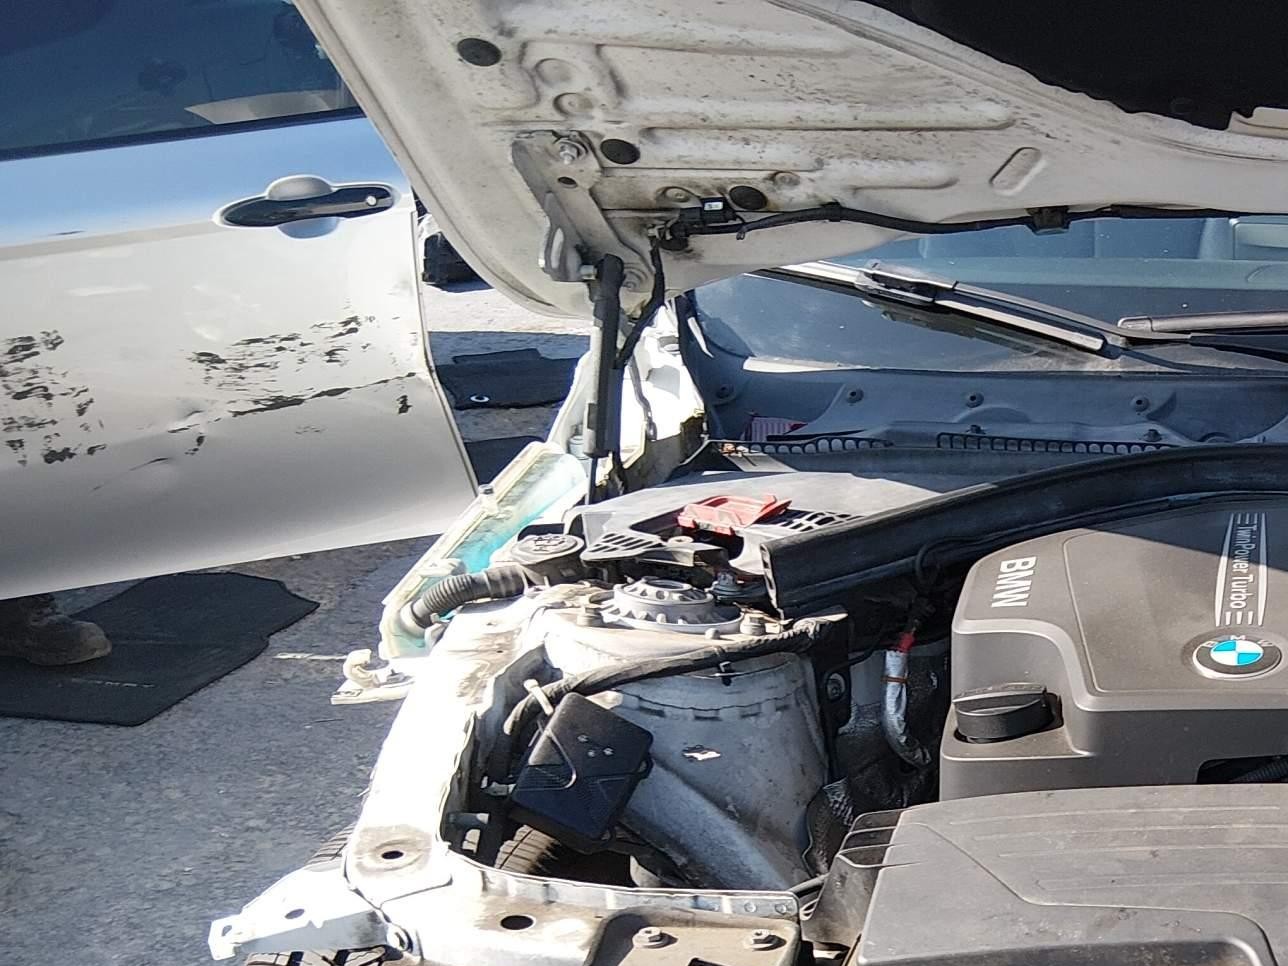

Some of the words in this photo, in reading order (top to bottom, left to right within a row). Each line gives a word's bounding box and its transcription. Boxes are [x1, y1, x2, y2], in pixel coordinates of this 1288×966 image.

[1232, 523, 1257, 573] TwinPower
[991, 556, 1037, 608] BMW
[1229, 573, 1254, 609] Turbo
